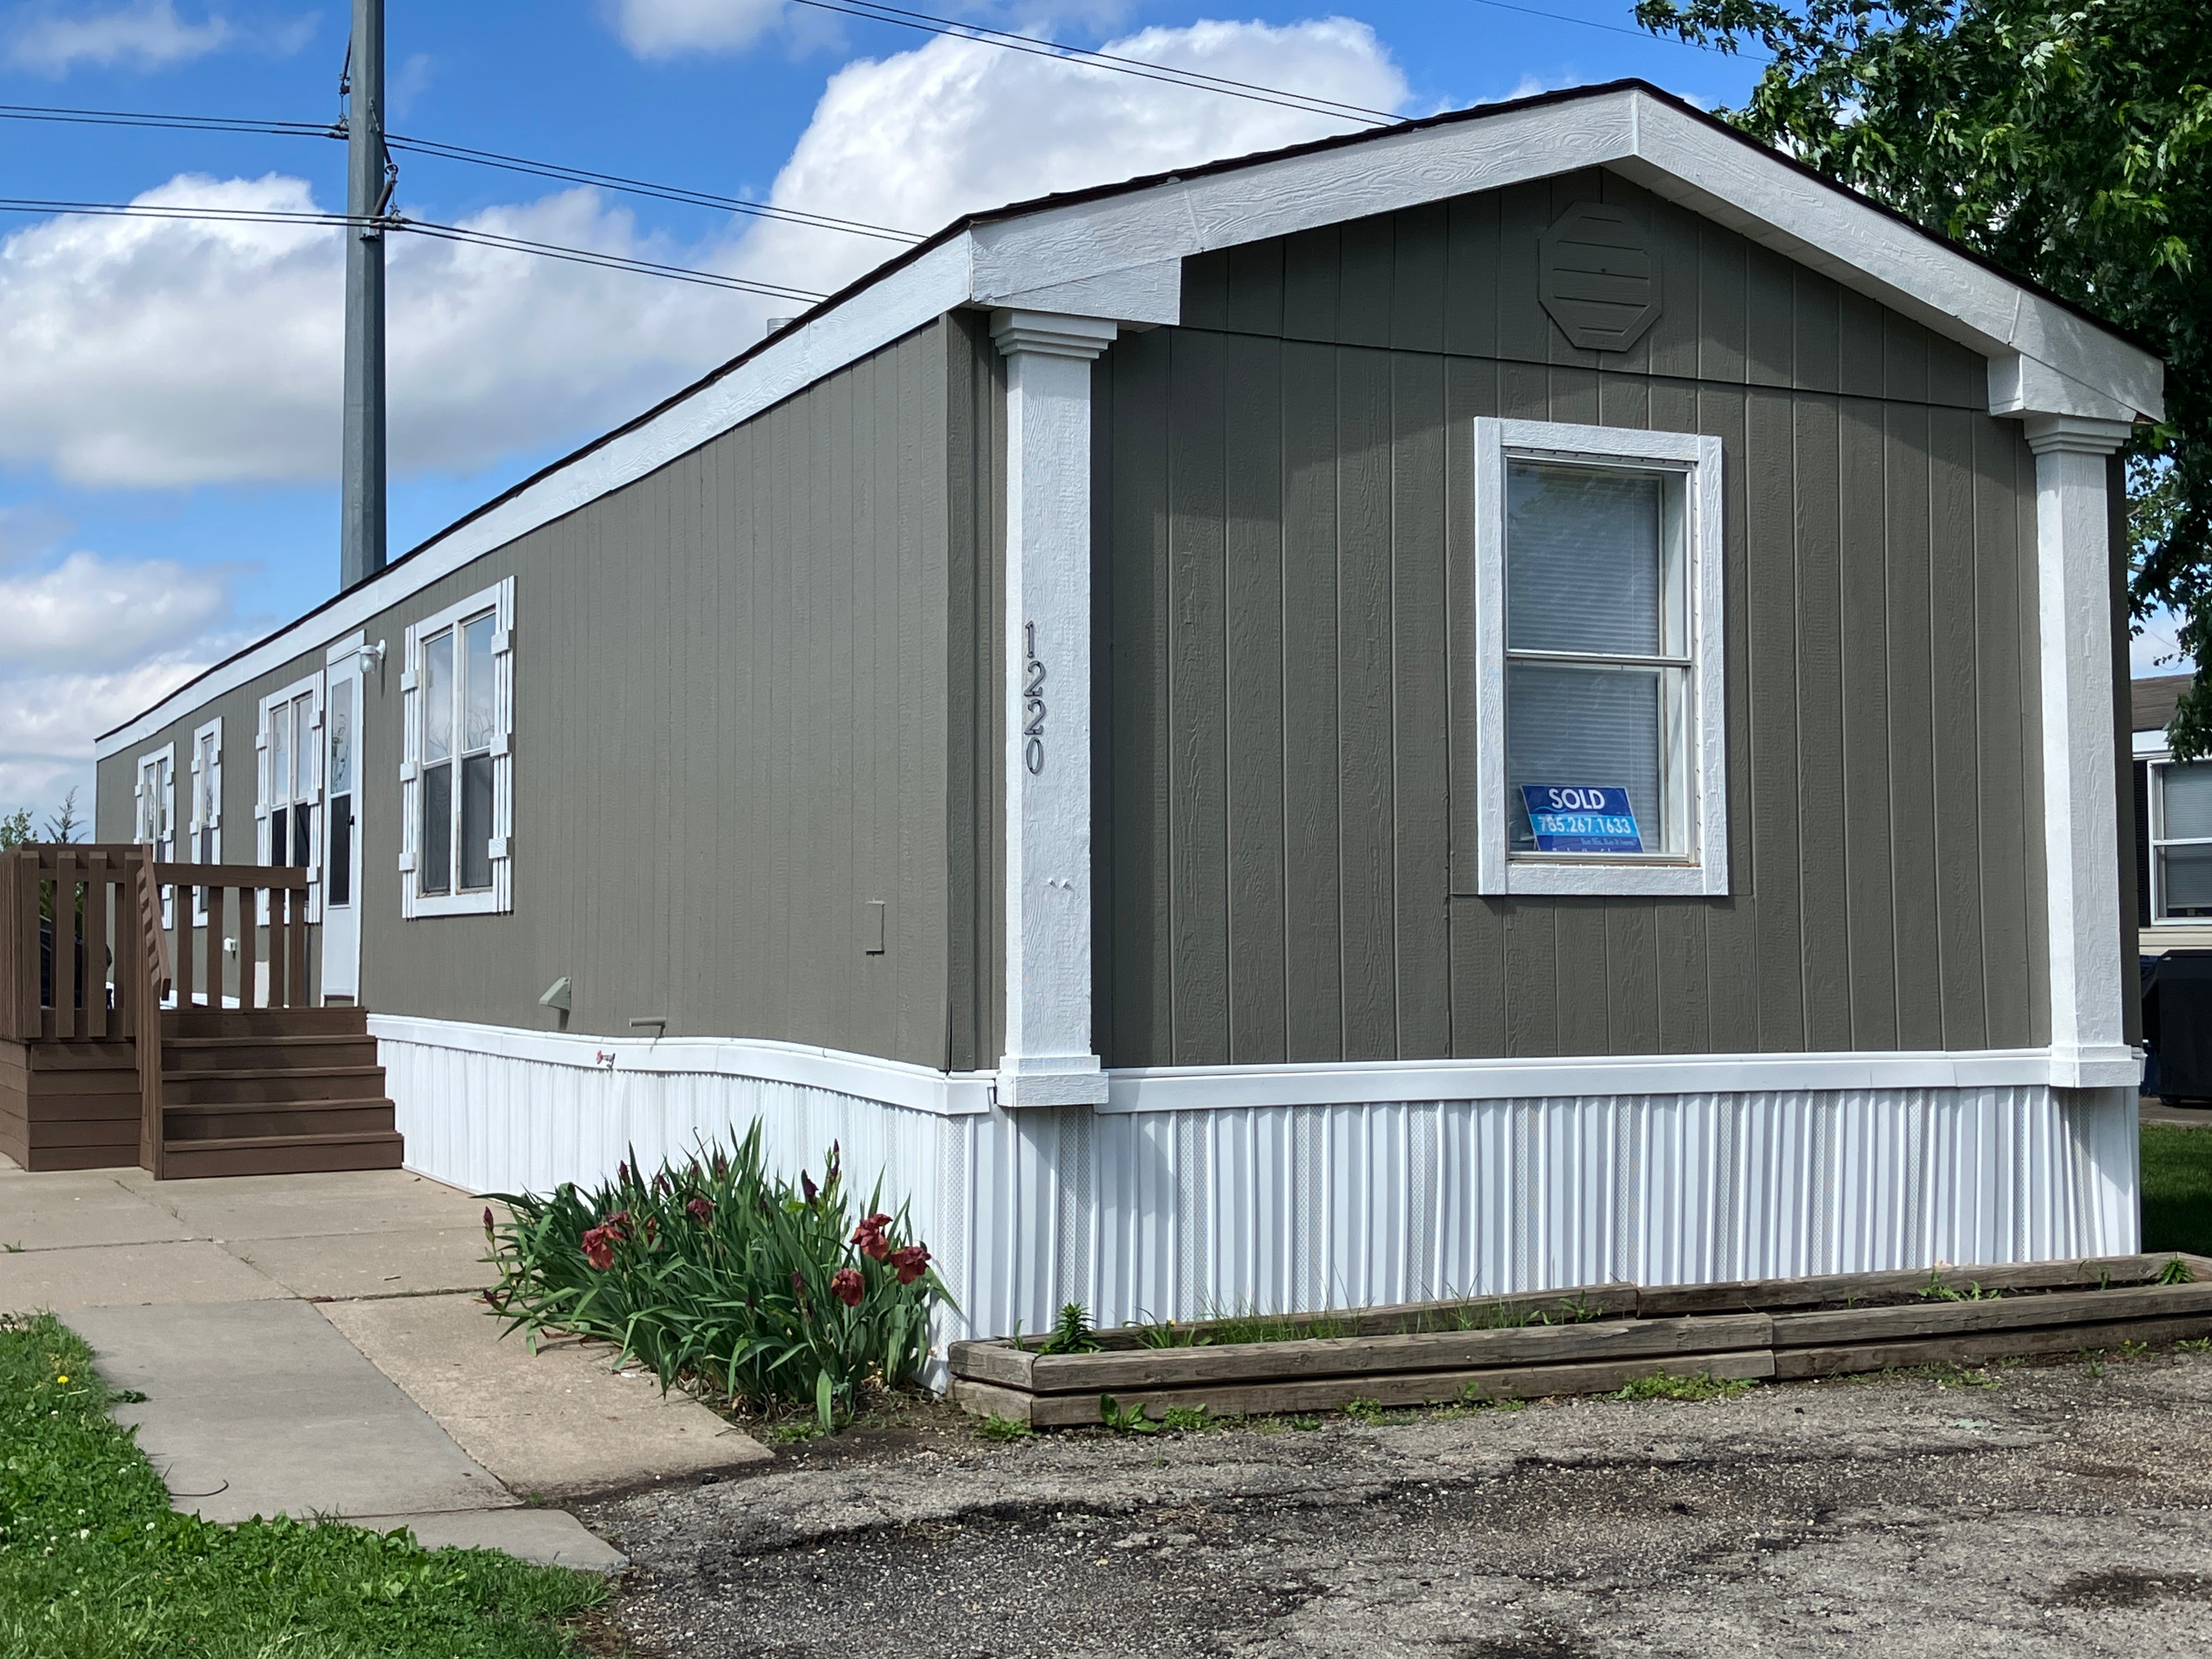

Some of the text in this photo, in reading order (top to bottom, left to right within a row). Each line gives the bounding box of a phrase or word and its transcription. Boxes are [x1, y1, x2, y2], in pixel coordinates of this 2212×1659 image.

[1024, 620, 1046, 774] 1220
[1548, 788, 1605, 809] SOLD
[1538, 816, 1631, 834] 785.267.1633
